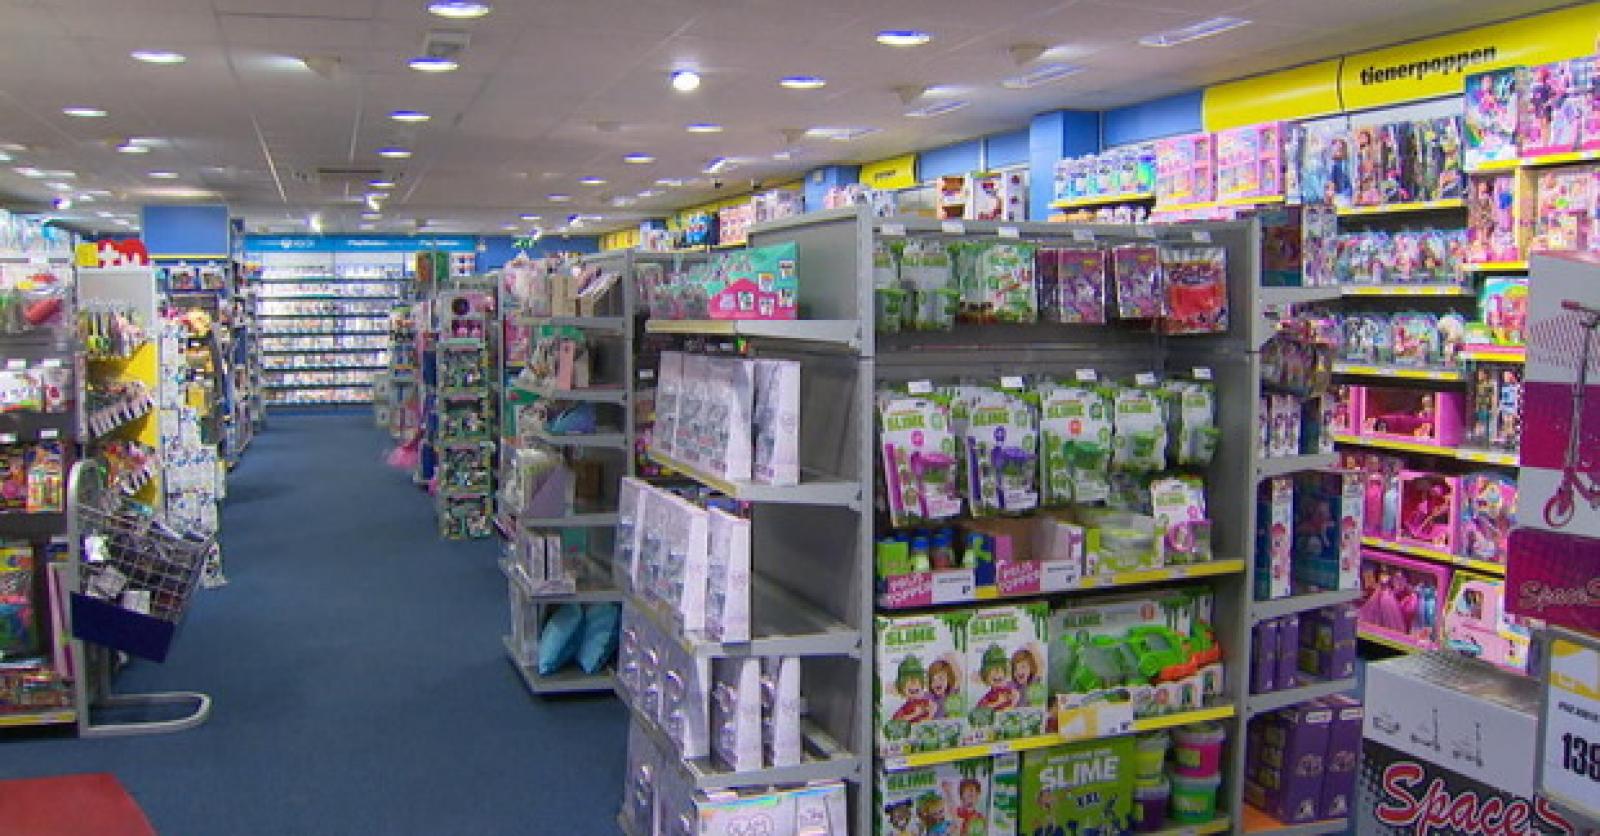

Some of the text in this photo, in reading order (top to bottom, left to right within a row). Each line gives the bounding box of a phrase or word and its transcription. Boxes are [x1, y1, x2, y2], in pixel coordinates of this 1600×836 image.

[1360, 46, 1497, 86] tienerpoppen
[885, 627, 937, 646] SLIME
[970, 616, 1018, 634] SLIME
[1039, 755, 1120, 793] SLIME
